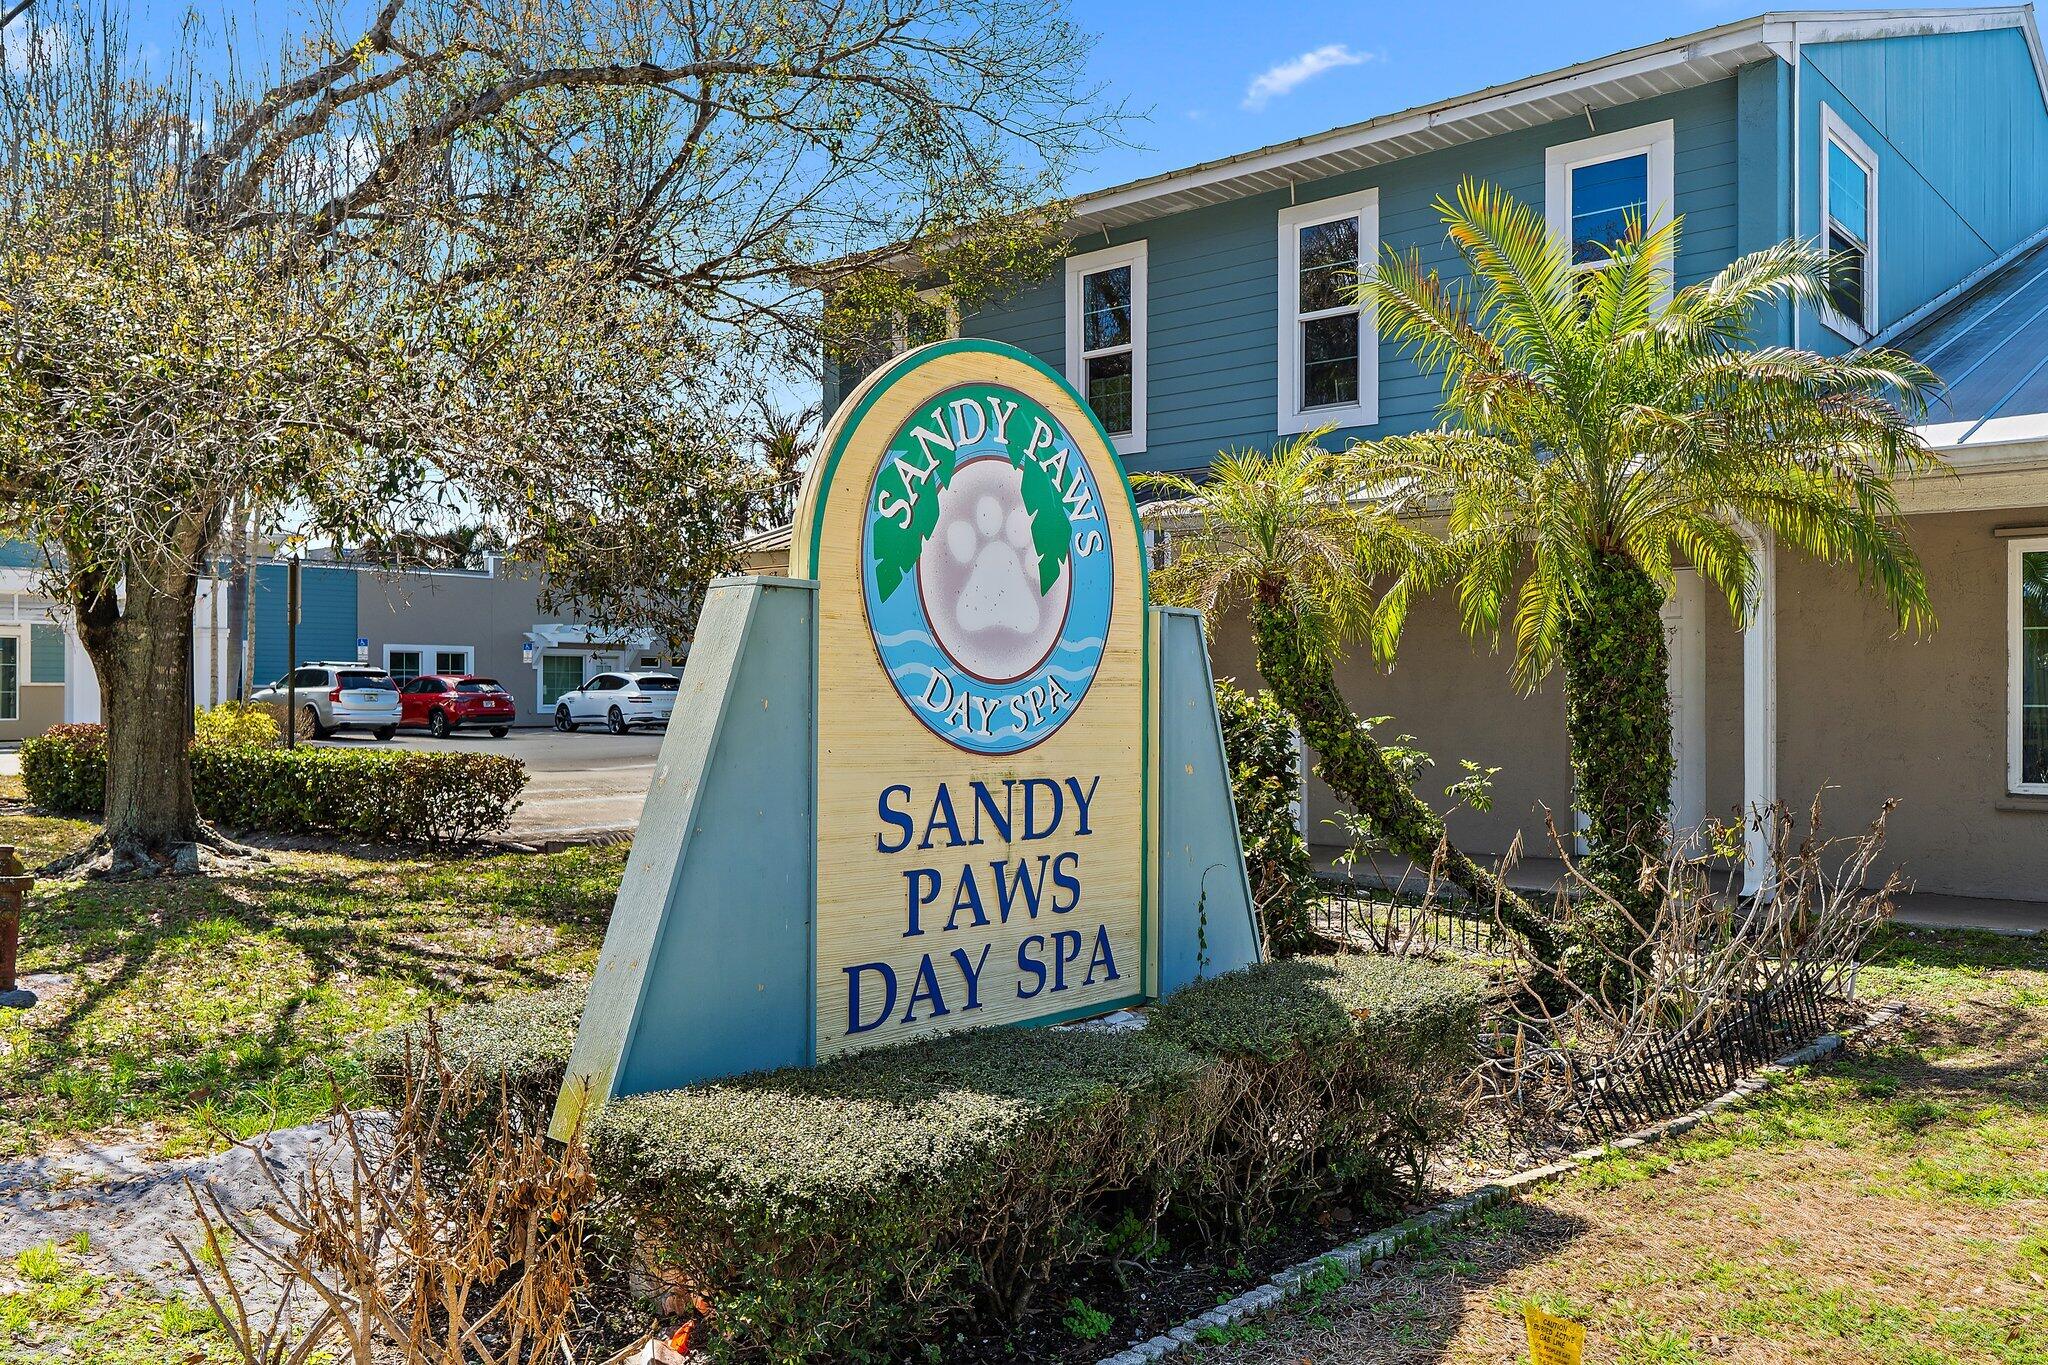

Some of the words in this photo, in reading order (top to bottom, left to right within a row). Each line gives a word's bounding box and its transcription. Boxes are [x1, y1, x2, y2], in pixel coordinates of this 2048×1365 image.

[878, 396, 1018, 529] SANDY
[1023, 416, 1104, 558] PAWS
[920, 667, 1001, 736] DAY
[1010, 675, 1071, 734] SPA
[877, 776, 1100, 854] SANDY
[902, 852, 1081, 938] PAWS
[842, 944, 991, 1036] DAY
[1016, 924, 1121, 999] SPA
[1539, 1333, 1551, 1344] GAS
[1543, 1318, 1568, 1333] CAUTION
[1555, 1331, 1575, 1344] ACTIVE
